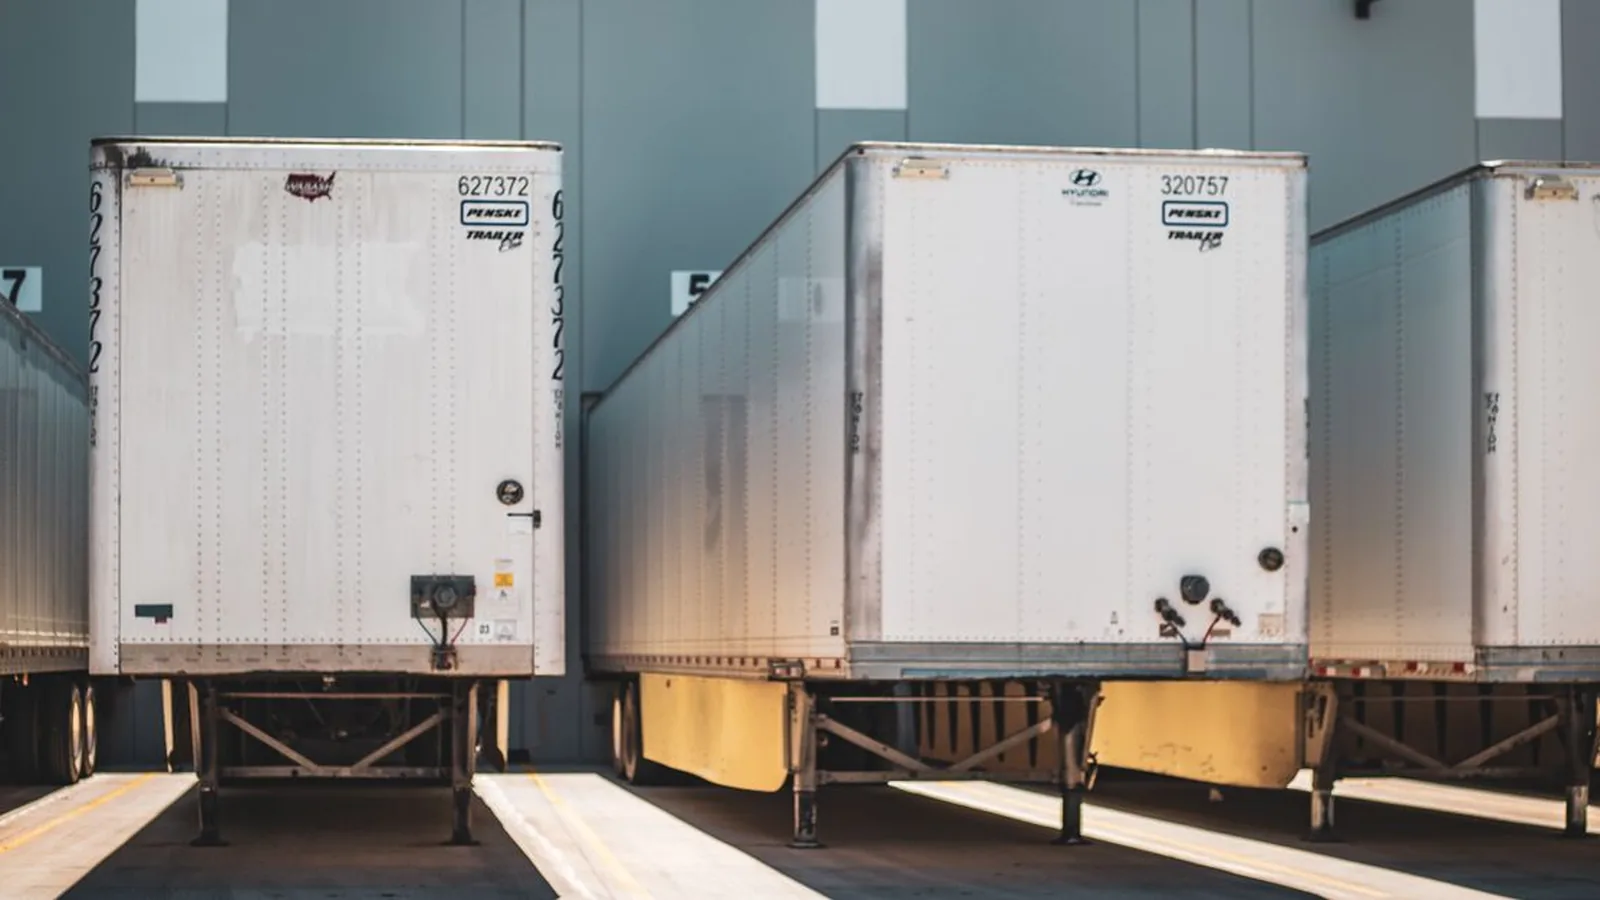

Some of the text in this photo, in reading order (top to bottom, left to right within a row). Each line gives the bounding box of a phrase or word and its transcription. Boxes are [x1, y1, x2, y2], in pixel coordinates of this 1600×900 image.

[458, 175, 529, 197] 627372
[1161, 174, 1229, 196] 320757
[466, 208, 523, 218] PENSKE
[1168, 208, 1222, 218] PENSKE
[466, 230, 525, 241] TRAILER
[1168, 231, 1224, 241] TRAILER
[3, 269, 27, 306] 7
[89, 181, 102, 374] 627372
[551, 189, 564, 381] 627372
